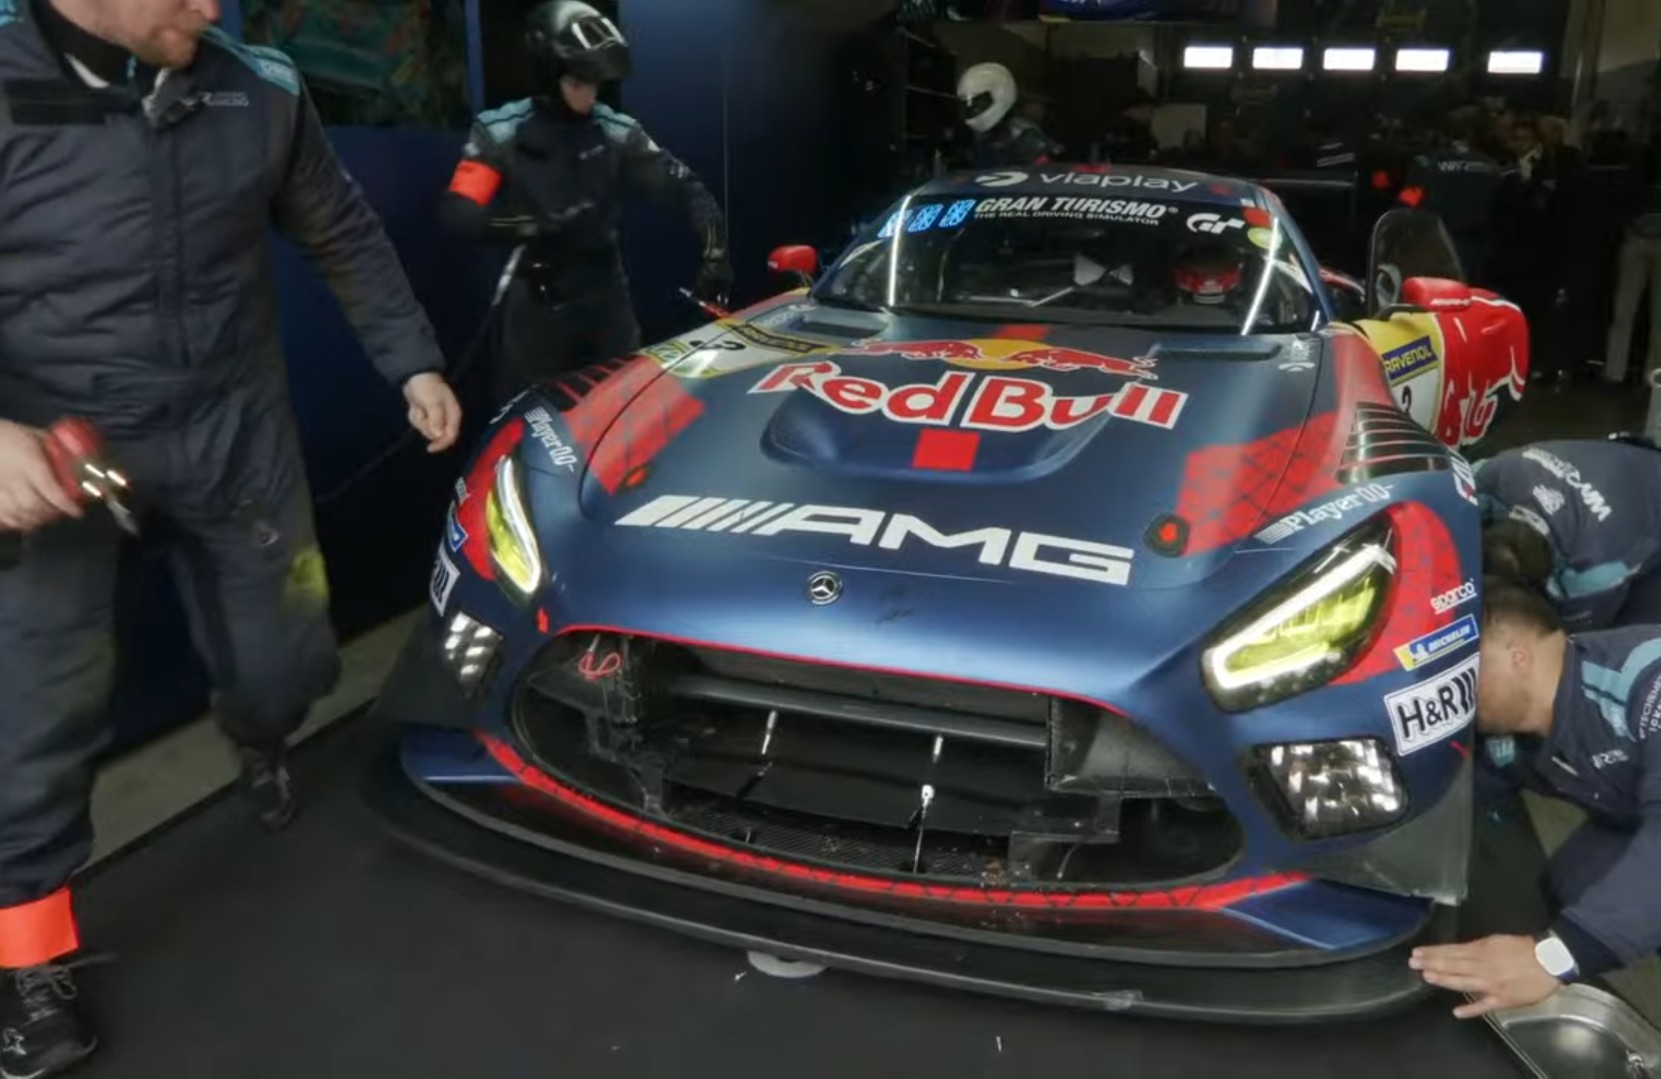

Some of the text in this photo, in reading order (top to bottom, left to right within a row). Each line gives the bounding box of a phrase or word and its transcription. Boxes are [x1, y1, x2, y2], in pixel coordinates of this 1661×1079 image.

[1041, 171, 1198, 193] viaplay
[975, 196, 1049, 213] GRAN
[975, 211, 996, 219] THE
[1033, 211, 1084, 219] DRIVING
[1086, 213, 1159, 225] SIMULATOR
[1385, 344, 1433, 373] RAVENOL
[747, 360, 1189, 433] Red Bull
[751, 504, 1134, 586] AMG
[1397, 685, 1459, 739] H&R
